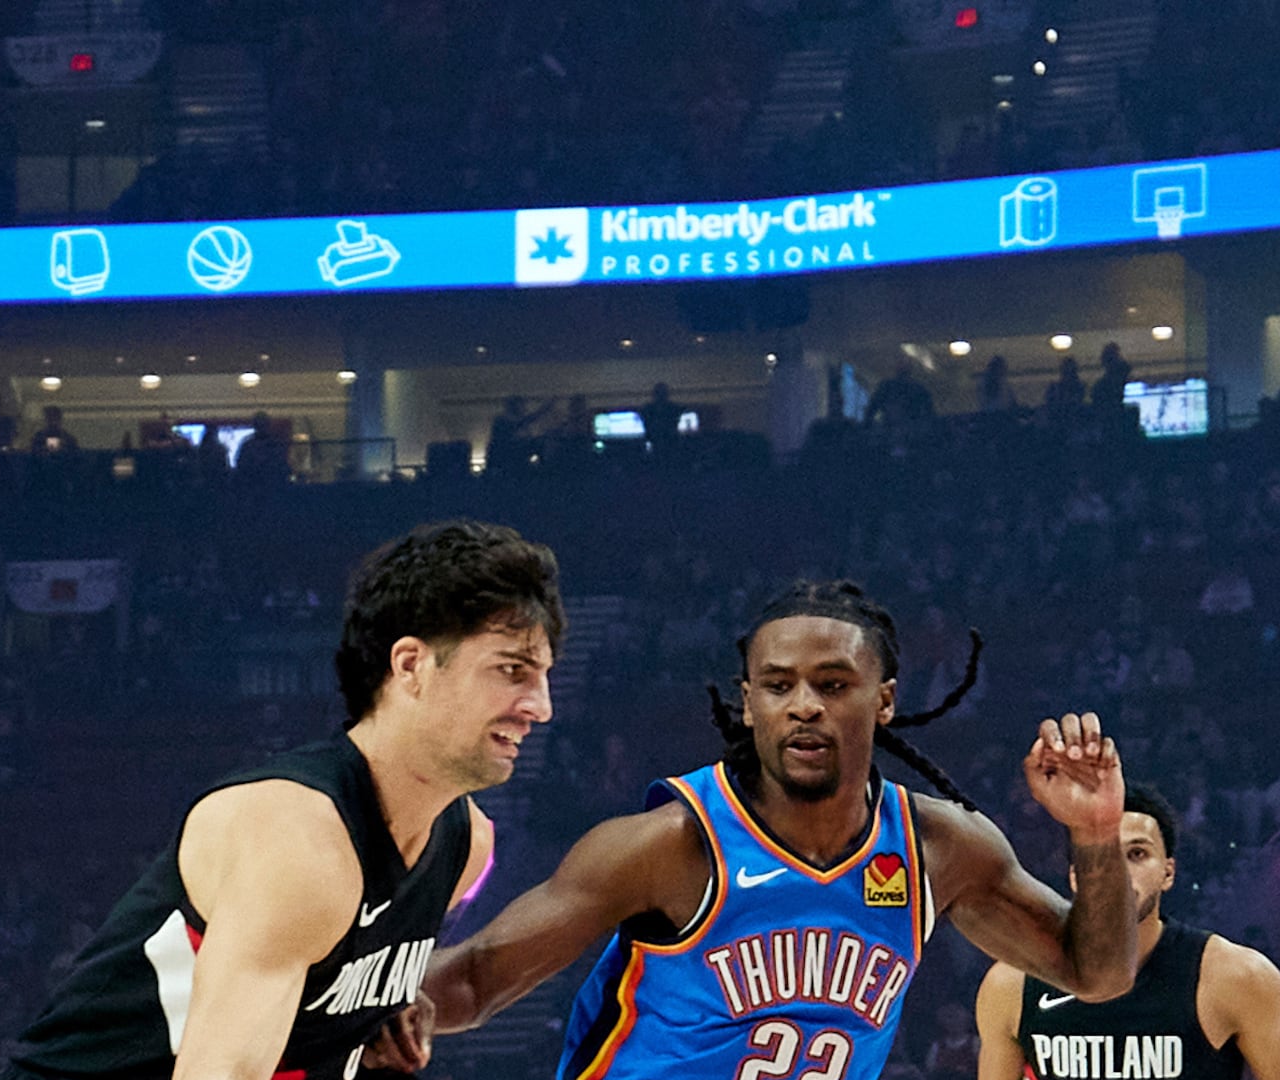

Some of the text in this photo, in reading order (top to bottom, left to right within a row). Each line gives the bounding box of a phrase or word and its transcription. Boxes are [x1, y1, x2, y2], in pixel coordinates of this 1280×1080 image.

[602, 241, 875, 276] PROFESSIONAL
[706, 929, 909, 1030] THUNDER
[1031, 1033, 1184, 1080] PORTLAND
